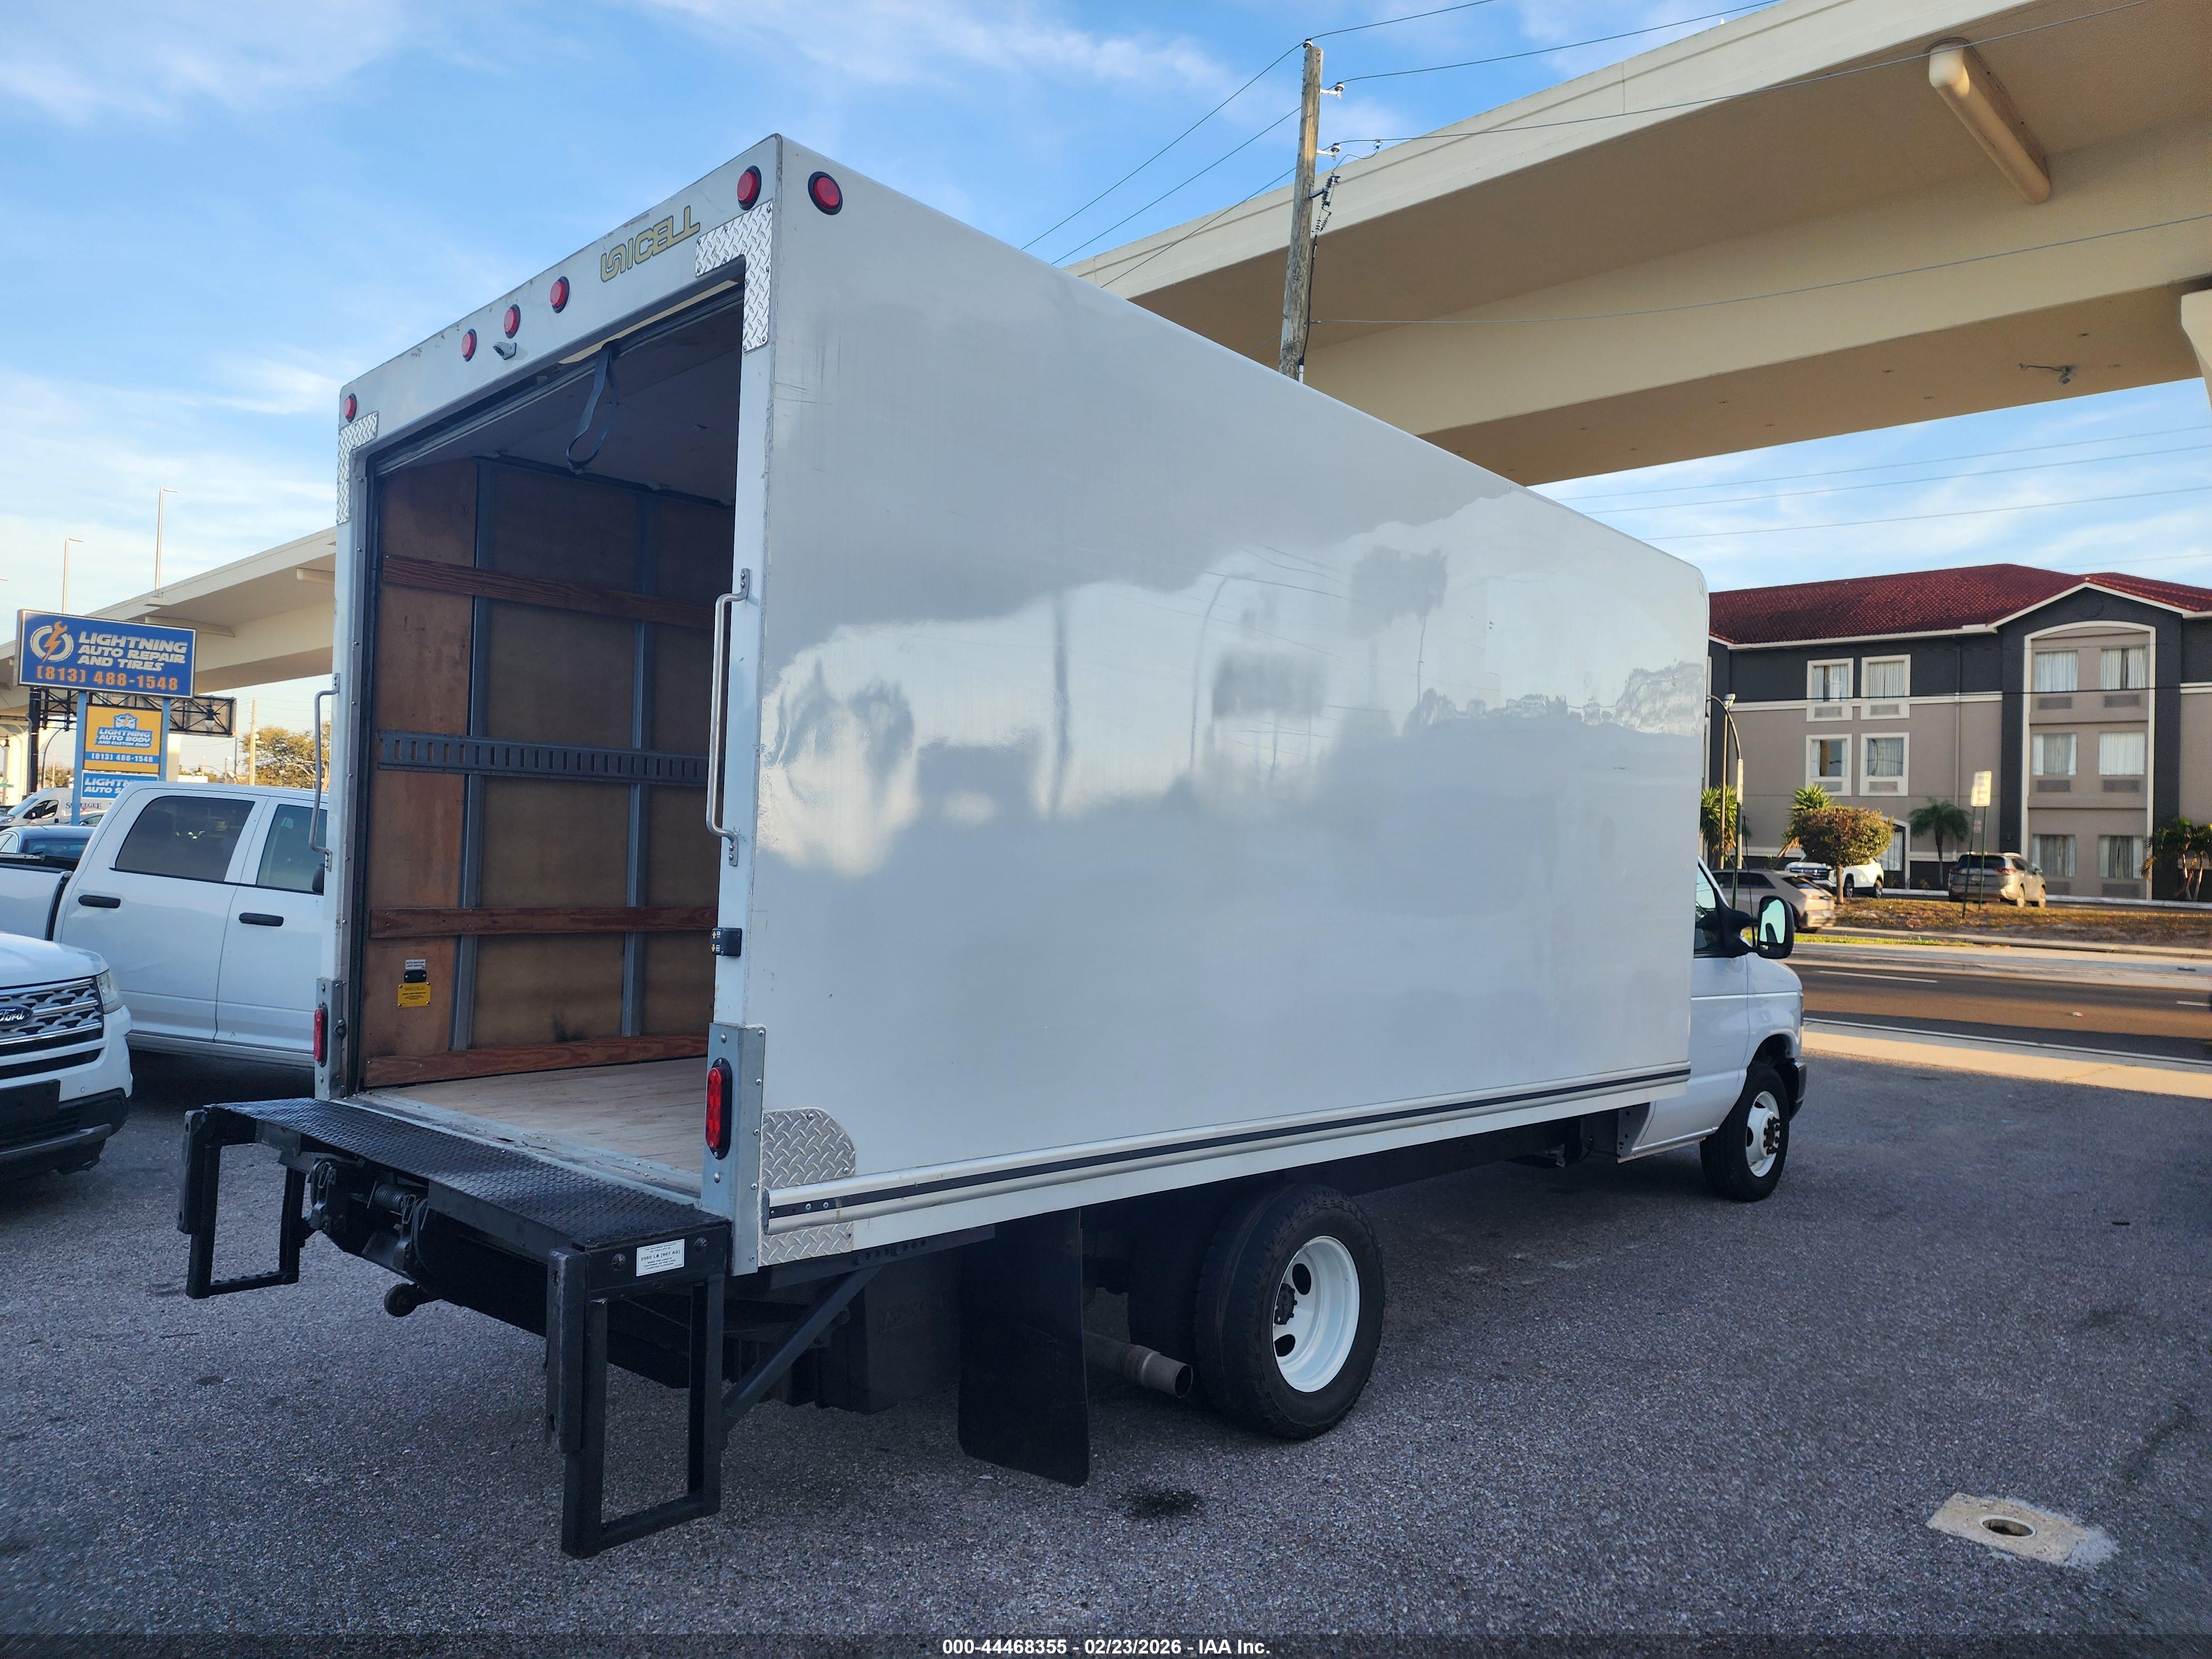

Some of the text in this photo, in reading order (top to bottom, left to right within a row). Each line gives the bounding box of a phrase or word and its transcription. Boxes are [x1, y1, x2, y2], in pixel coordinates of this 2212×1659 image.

[601, 205, 701, 283] UNICELL
[78, 632, 188, 654] LIGHTNING
[77, 645, 186, 664] AUTO REPAIR
[77, 655, 164, 671] AND TIRES
[37, 665, 178, 691] (813) 488-1548
[99, 728, 151, 737] LIGHTNING
[85, 778, 133, 787] LIGHTN
[0, 1008, 25, 1022] Ford
